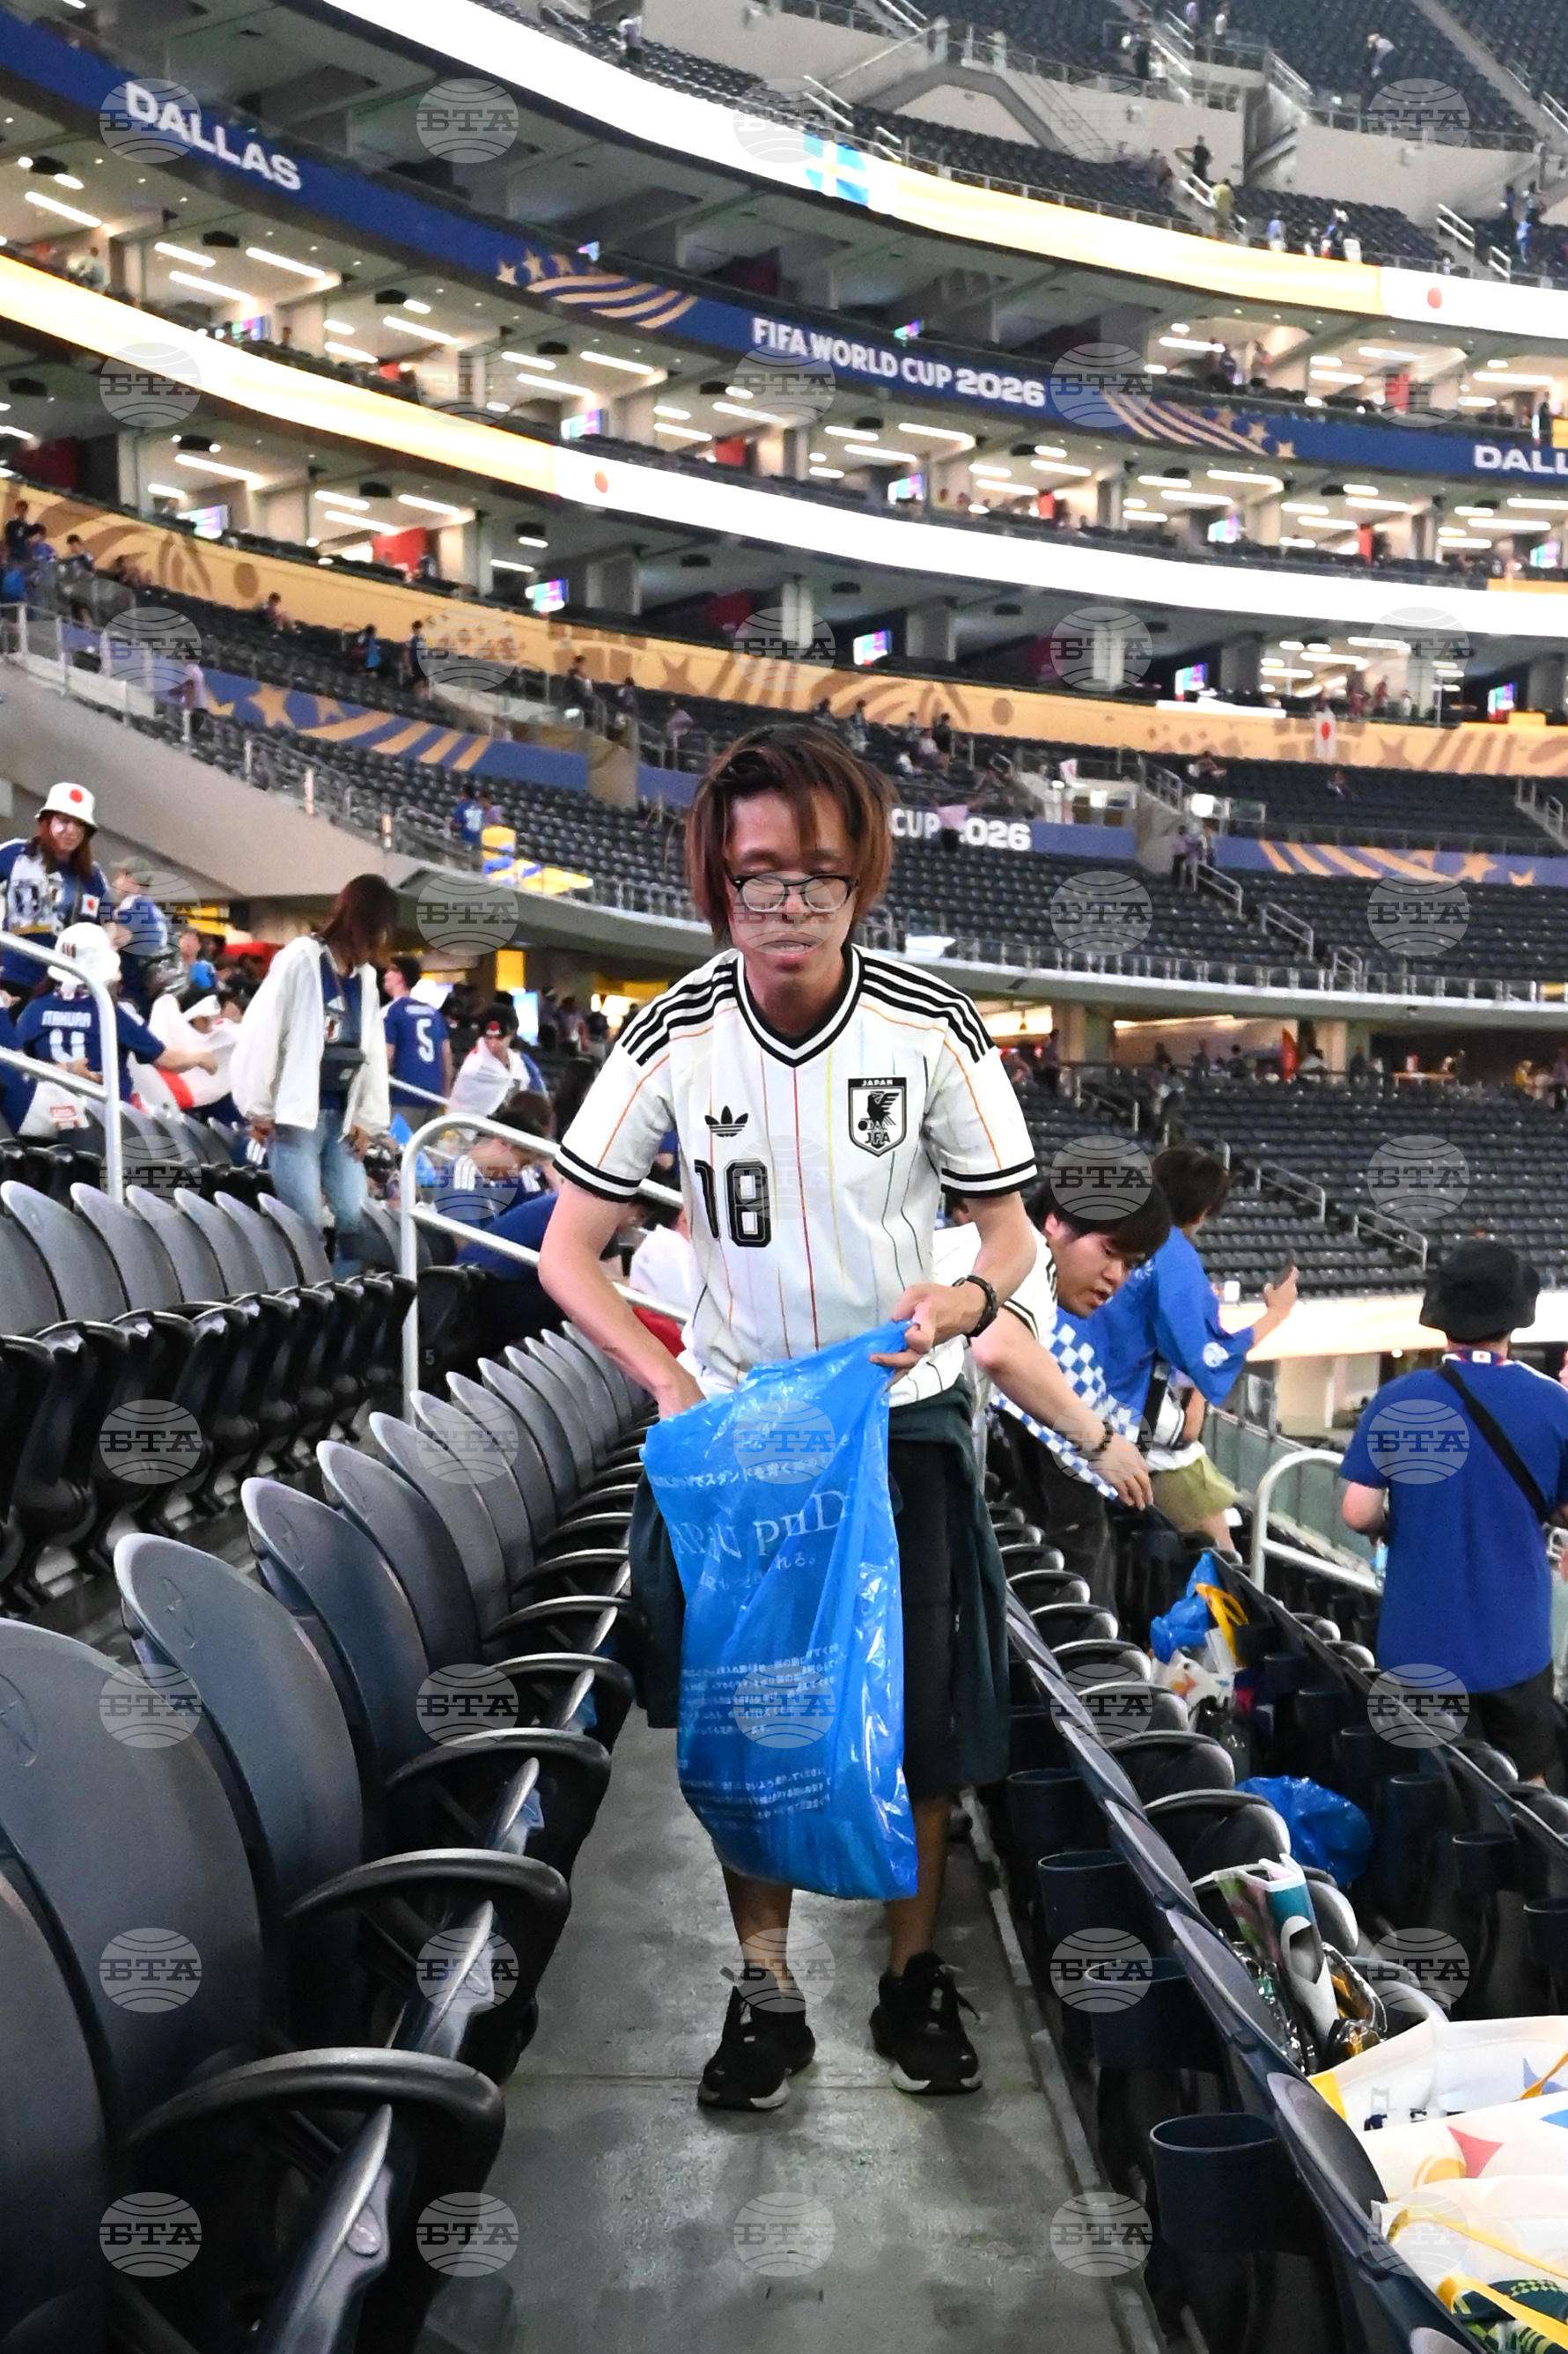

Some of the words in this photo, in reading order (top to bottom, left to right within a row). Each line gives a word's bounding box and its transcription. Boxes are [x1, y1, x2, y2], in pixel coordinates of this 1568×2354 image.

[126, 81, 302, 190] DALLAS
[752, 317, 807, 357] FIFA
[809, 332, 898, 378] WORLD
[901, 358, 953, 389] CUP
[955, 368, 1047, 408] 2026
[889, 808, 941, 839] CUP
[959, 816, 1033, 852] 026
[416, 1017, 435, 1063] 5
[864, 1132, 891, 1144] JFA
[694, 1158, 772, 1248] 18
